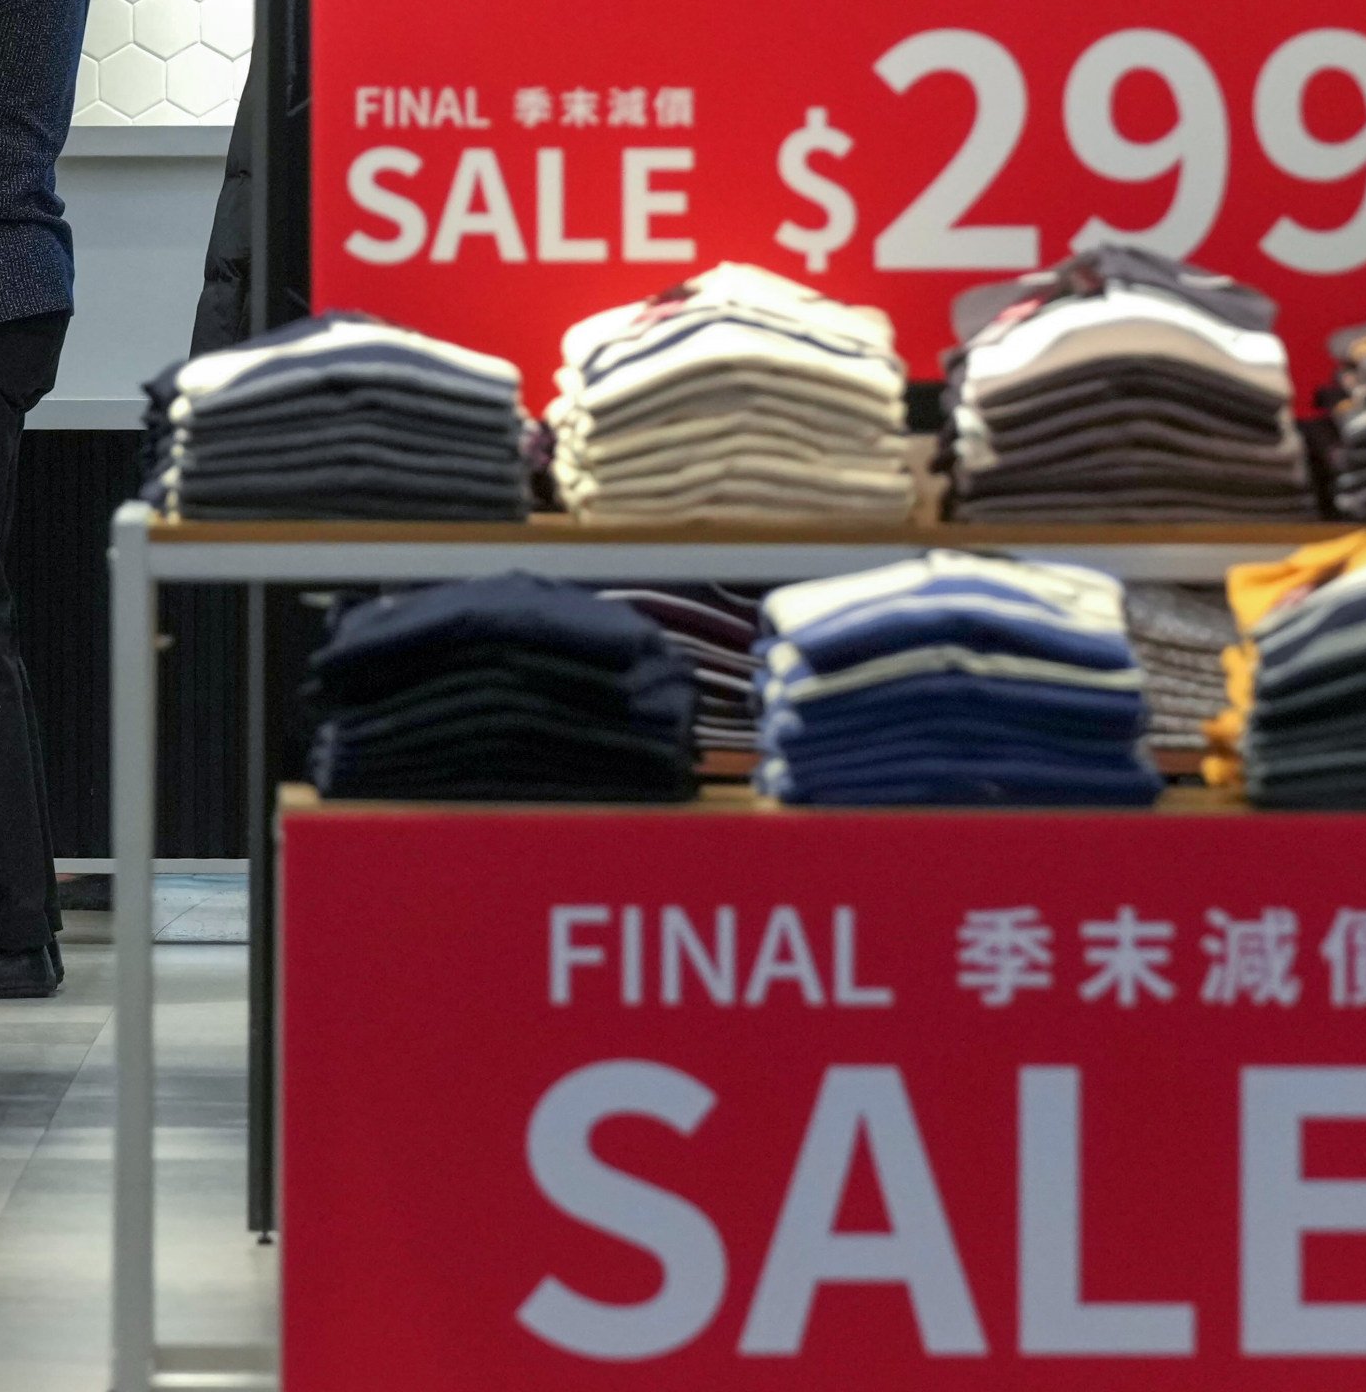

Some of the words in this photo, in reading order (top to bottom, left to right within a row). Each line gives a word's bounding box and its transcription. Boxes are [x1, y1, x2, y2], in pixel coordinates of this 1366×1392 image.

[355, 86, 491, 129] FINAL
[514, 87, 694, 128] 季末減價
[345, 146, 697, 264] SALE
[549, 905, 893, 1007] FINAL
